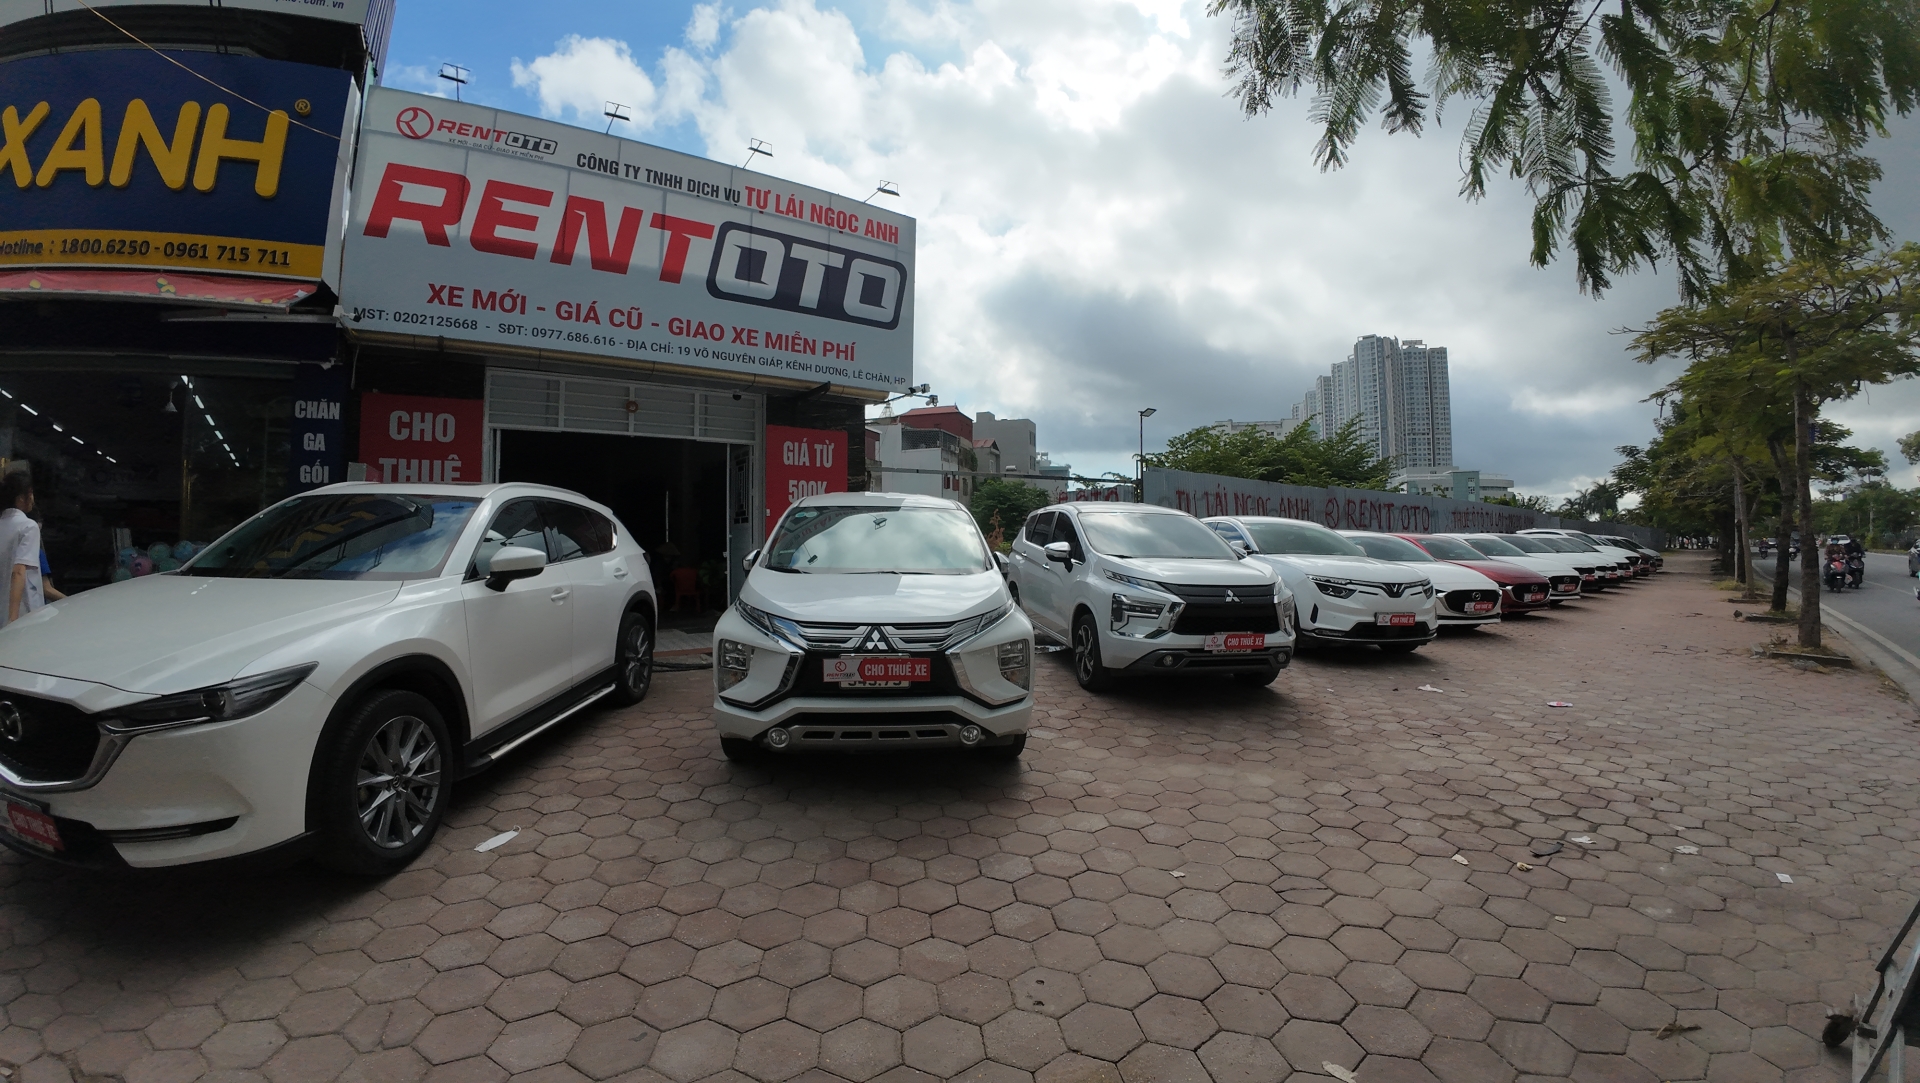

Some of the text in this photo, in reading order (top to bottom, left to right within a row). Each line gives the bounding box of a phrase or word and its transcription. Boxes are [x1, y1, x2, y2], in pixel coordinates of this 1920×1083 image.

[0, 98, 289, 198] XANH
[577, 153, 899, 245] CÔNG TY TNHH DỊCH VỤ TỰ LÁI NGỌC ANH
[60, 238, 150, 256] 1800.6250
[163, 241, 208, 260] 0961
[216, 244, 250, 263] 715
[256, 248, 290, 267] 711
[427, 283, 464, 308] XE
[472, 288, 527, 316] MỚI
[555, 300, 601, 326] GIÁ
[609, 306, 643, 331] CŨ
[668, 317, 725, 342] GIAO
[731, 326, 759, 347] XE
[764, 331, 817, 358] MIỄN
[822, 341, 857, 362] PHÍ
[353, 306, 390, 322] MST:
[393, 311, 478, 331] 0202125668
[498, 323, 528, 338] SĐT:
[531, 327, 616, 347] 0977.686.616
[627, 339, 648, 352] ĐỊA
[678, 346, 691, 357] 19
[694, 348, 710, 359] VÕ
[712, 349, 756, 365] NGUYÊN
[759, 355, 783, 370] GIÁP,
[786, 358, 812, 373] KÊNH
[815, 362, 850, 379] DƯƠNG,
[853, 368, 863, 380] LÊ
[866, 370, 893, 386] CHÂN,
[894, 375, 906, 386] HP
[294, 399, 341, 421] CHĂN
[389, 410, 455, 443] CHO
[303, 432, 326, 451] GA
[783, 438, 835, 468] GIÁ TỪ
[300, 459, 329, 484] GỐI
[378, 454, 462, 483] THUÊ
[788, 480, 827, 503] 500K
[1347, 498, 1394, 530] RENT
[1401, 504, 1430, 531] OTO
[1228, 638, 1240, 646] CHO
[1240, 636, 1254, 646] THUÊ
[1254, 637, 1264, 646] XE
[864, 662, 928, 676] CHO THUÊ XE
